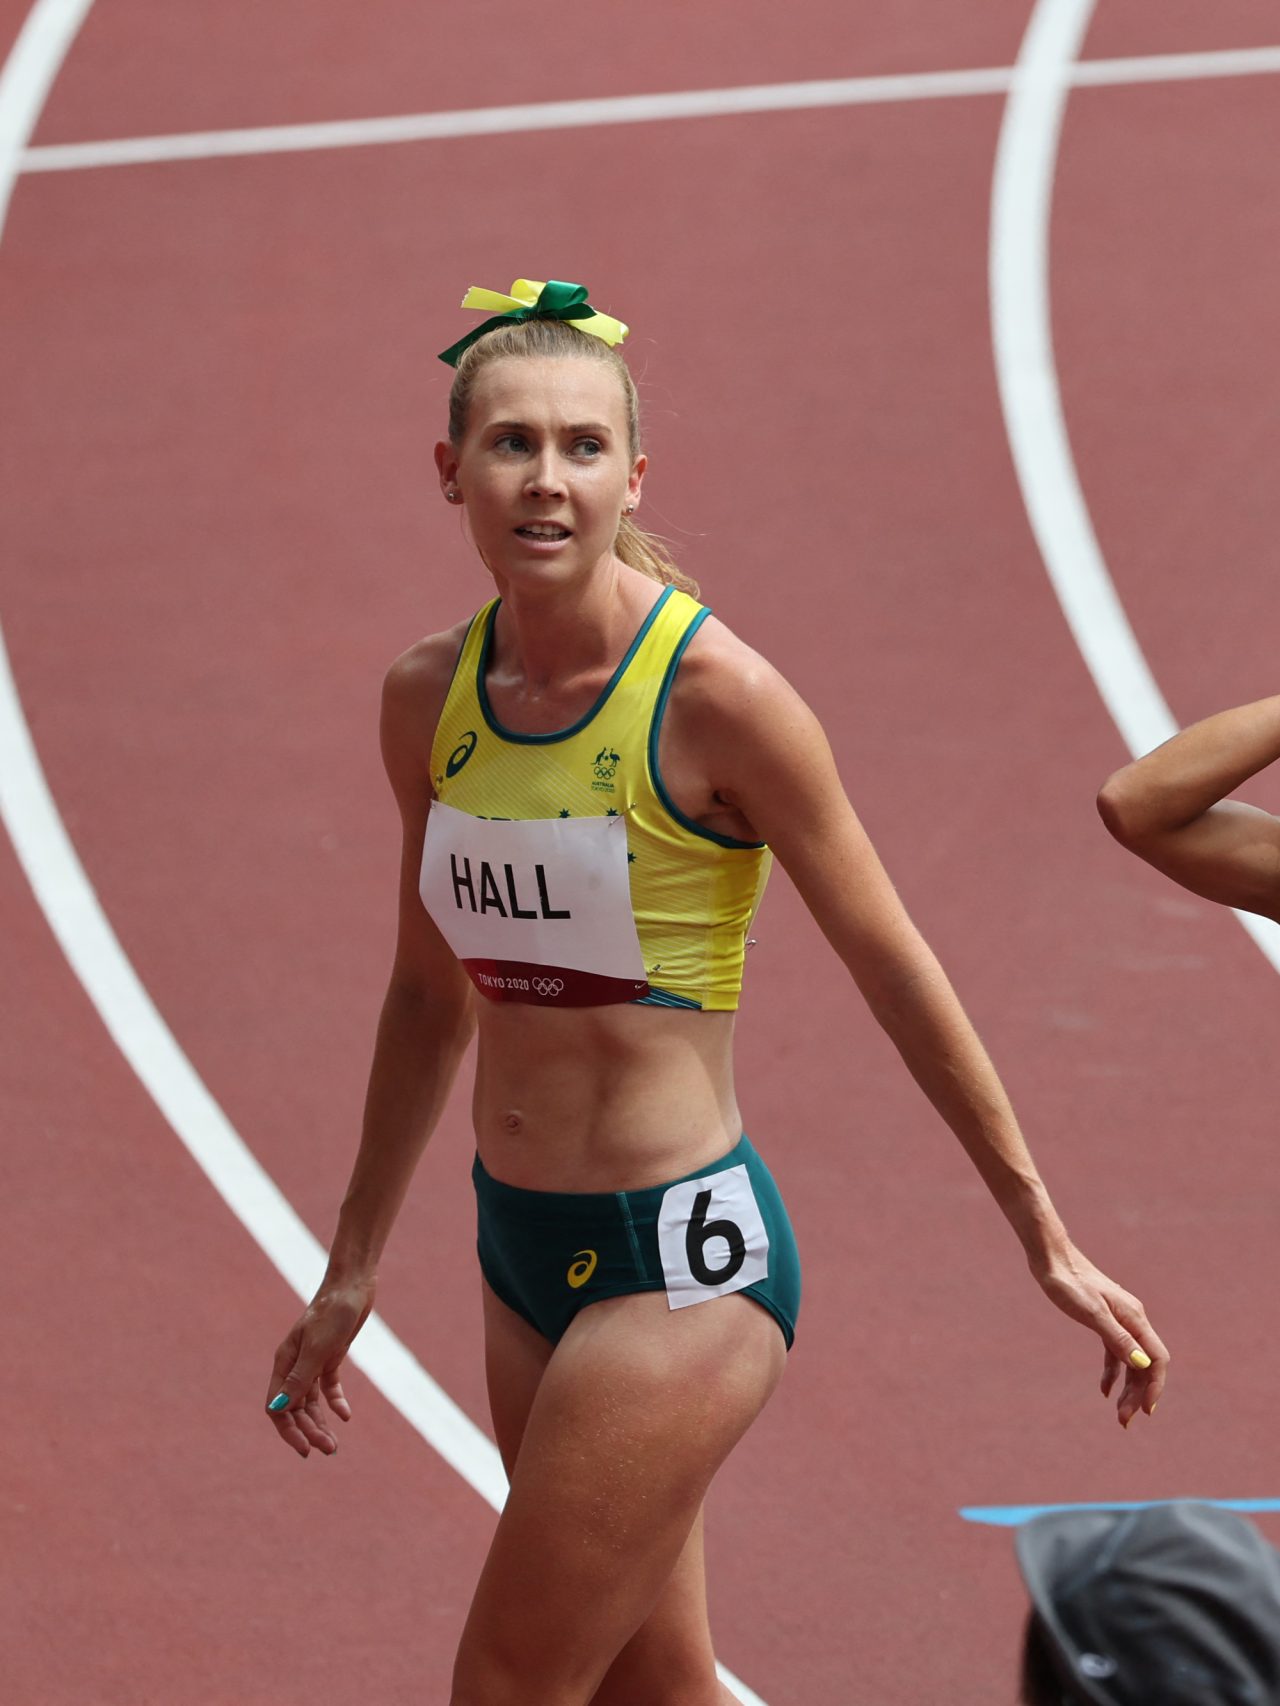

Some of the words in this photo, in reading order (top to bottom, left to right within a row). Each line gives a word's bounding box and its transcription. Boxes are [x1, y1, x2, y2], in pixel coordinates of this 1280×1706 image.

[450, 853, 571, 919] HALL
[478, 973, 505, 989] TOKYO
[506, 978, 530, 990] 2020
[686, 1189, 747, 1286] 6
